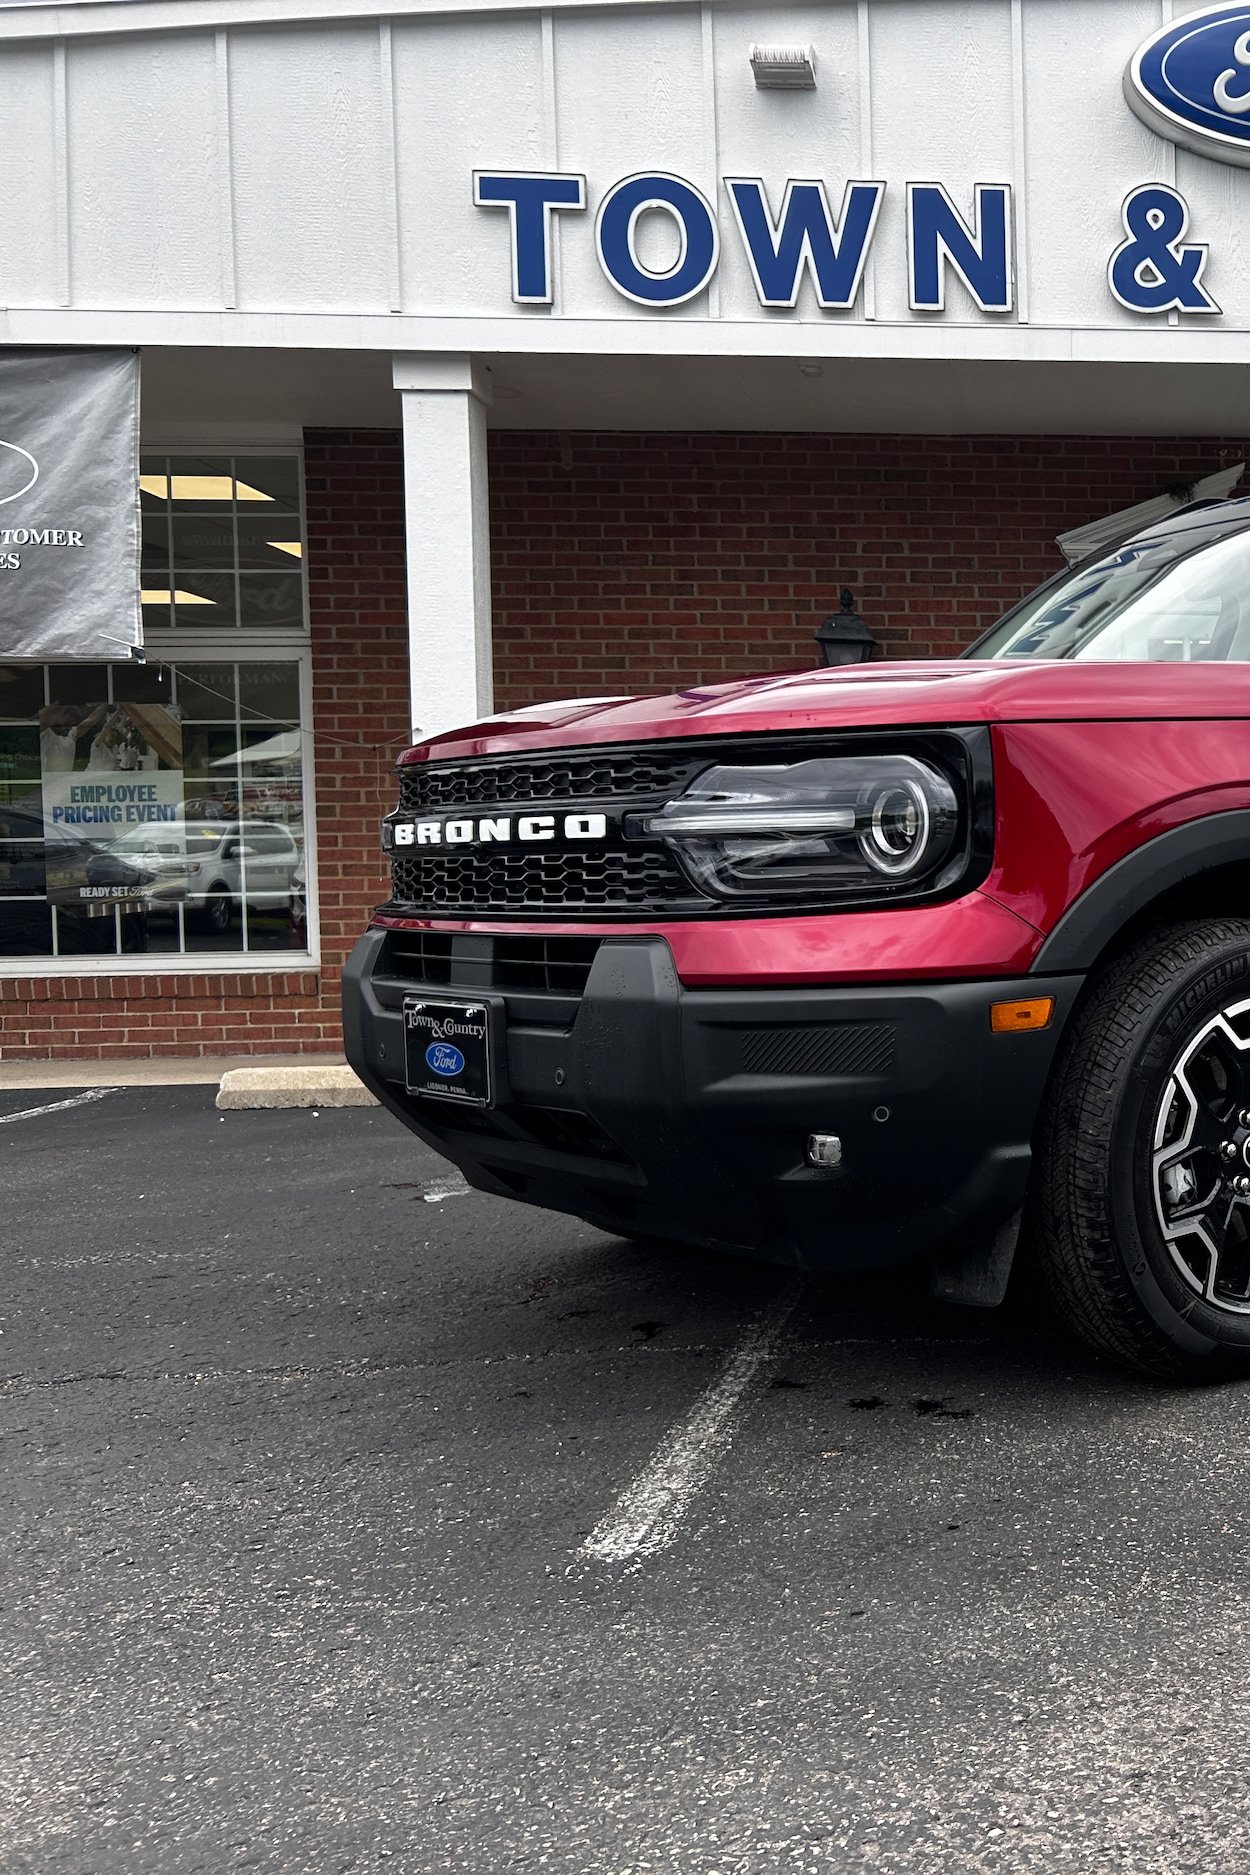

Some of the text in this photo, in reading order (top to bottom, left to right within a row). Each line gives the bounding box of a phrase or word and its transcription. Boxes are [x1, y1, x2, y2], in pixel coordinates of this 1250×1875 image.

[472, 170, 1014, 313] TOWN
[1107, 183, 1223, 314] &
[70, 785, 156, 803] EMPLOYEE
[52, 804, 177, 823] PRICING EVENT
[393, 814, 606, 846] BRONCO
[79, 886, 155, 897] READY SET Ford
[1166, 958, 1246, 1033] MICHELIN
[405, 1010, 486, 1040] Town & Country
[433, 1046, 457, 1070] Ford
